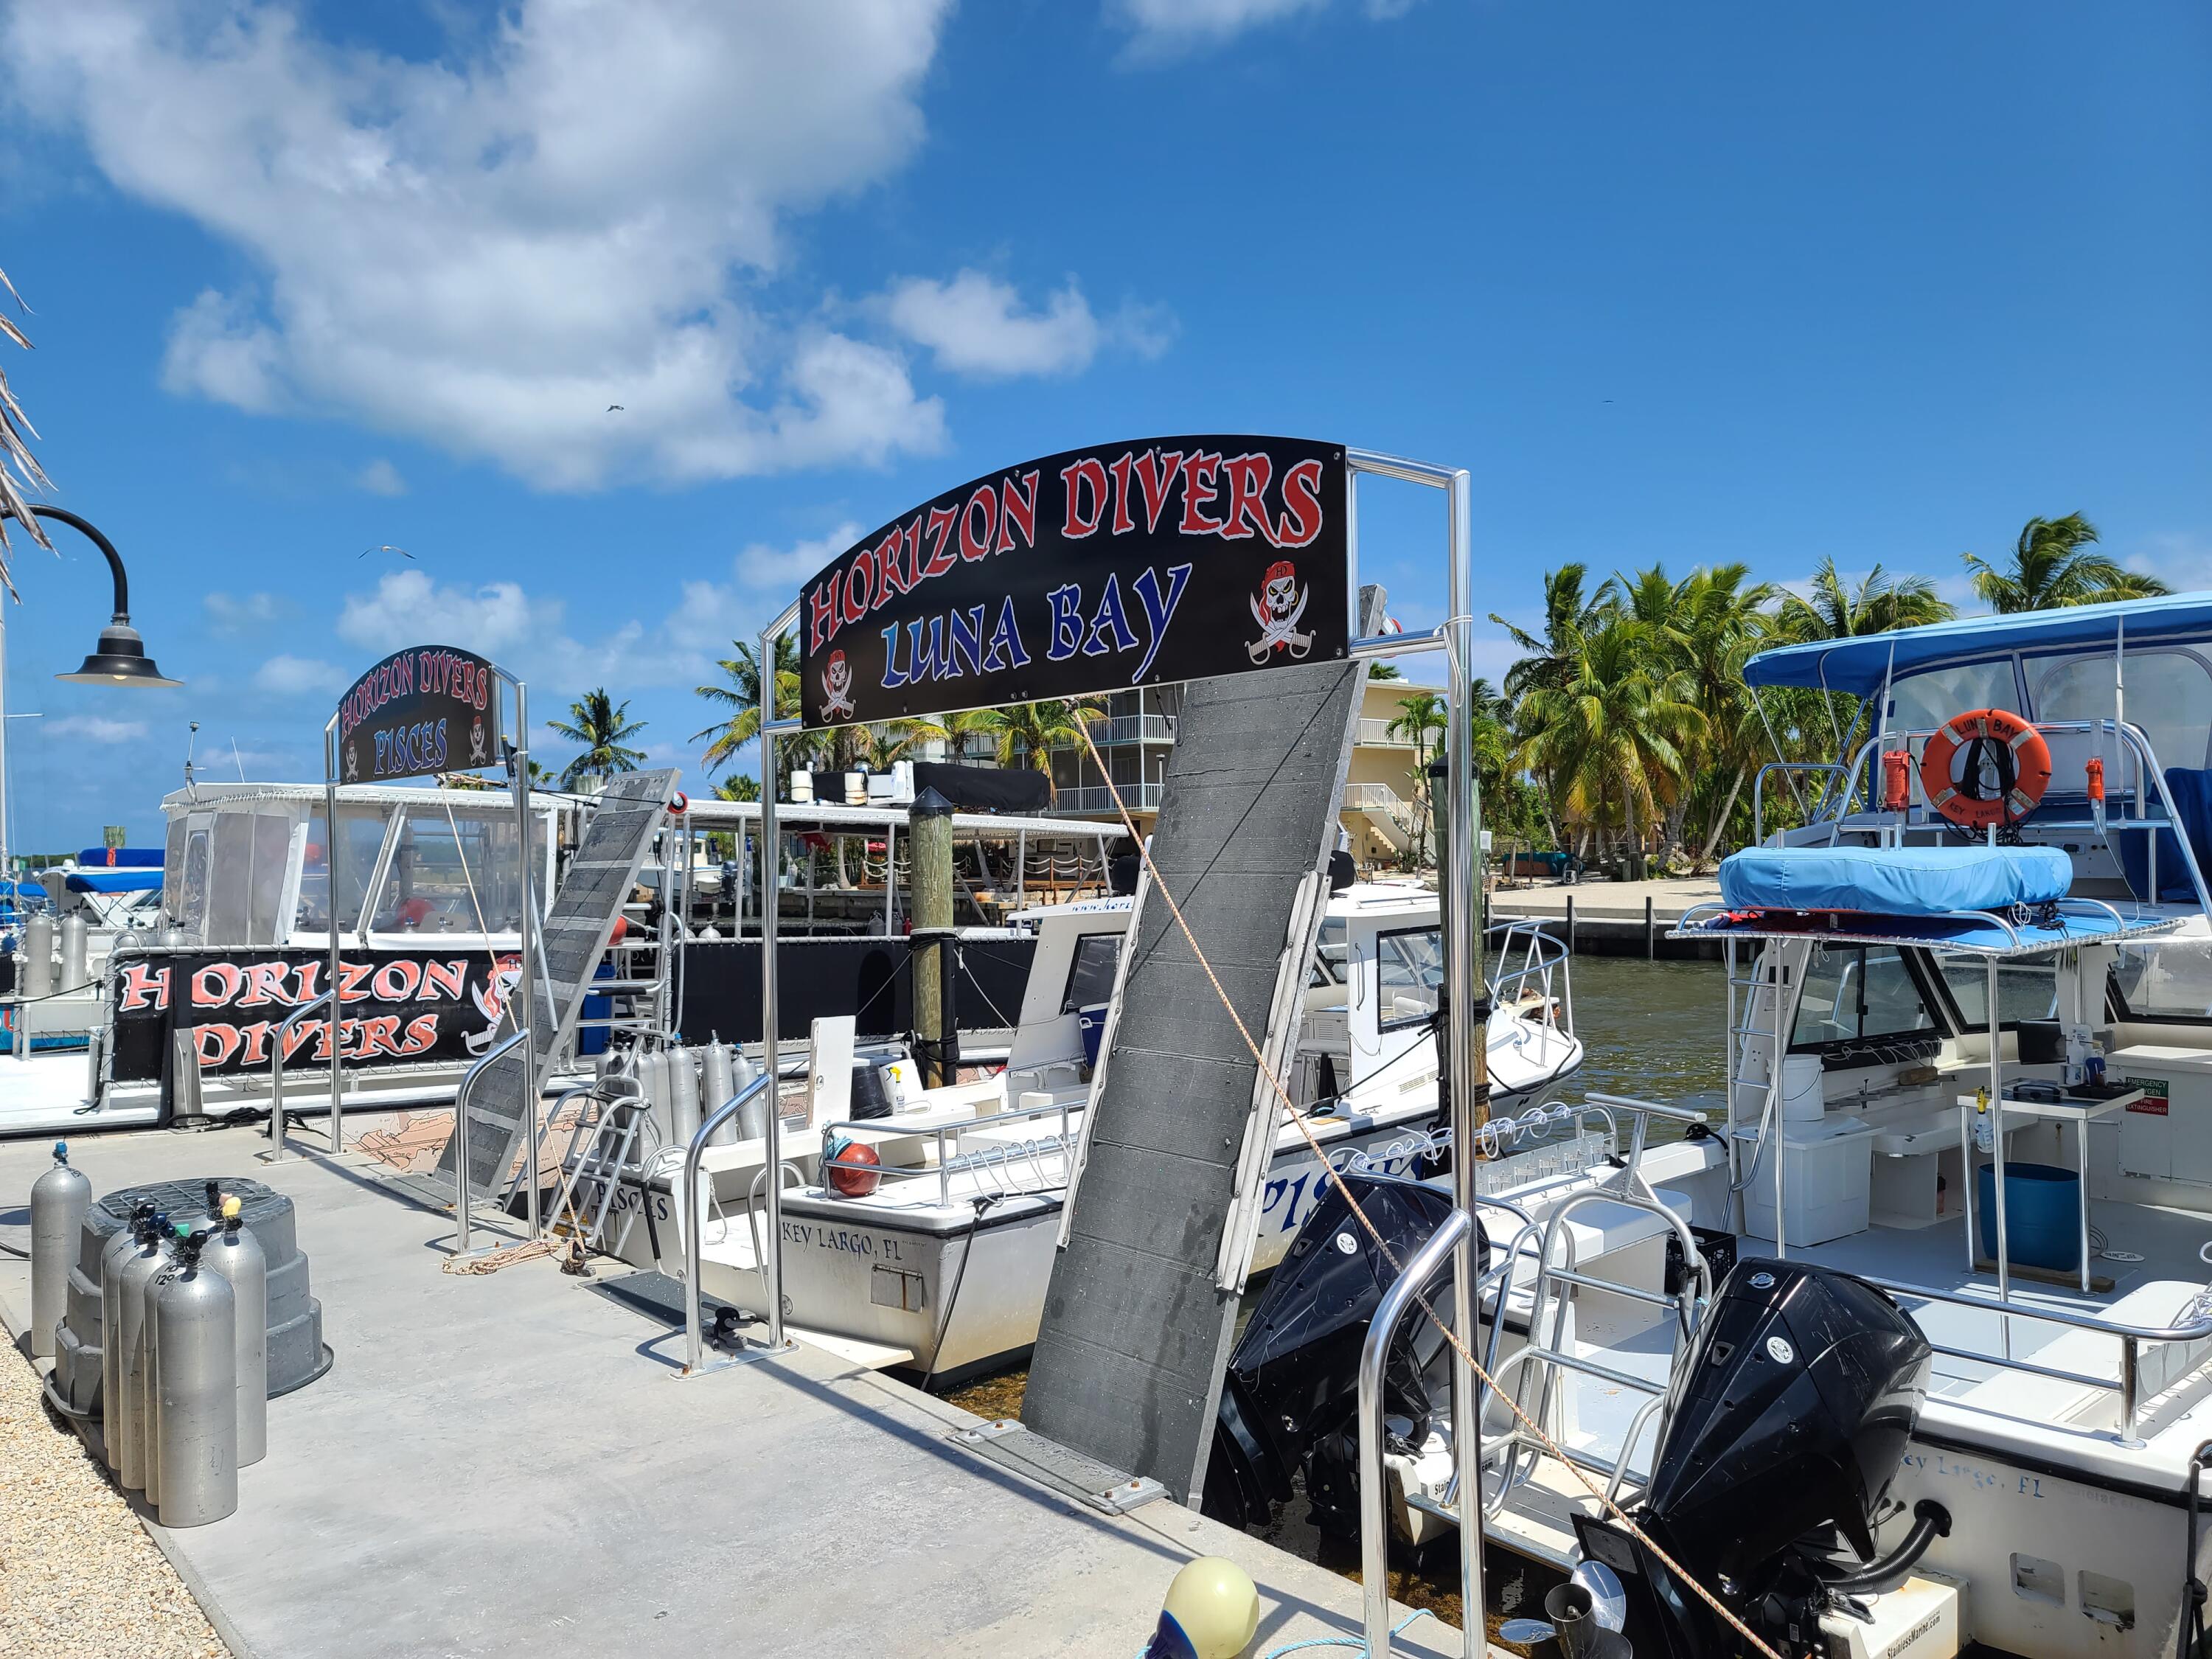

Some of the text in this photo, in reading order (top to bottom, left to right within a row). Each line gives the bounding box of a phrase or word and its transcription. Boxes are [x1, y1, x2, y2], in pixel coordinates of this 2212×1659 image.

[810, 448, 1324, 657] HORIZON DIVERS
[880, 562, 1194, 689] LUNA BAY
[341, 650, 487, 744] HORIZON DIVERS
[374, 718, 448, 774] PISCES
[1955, 717, 2020, 738] LUN BAY
[1073, 899, 1133, 912] www.hori
[119, 959, 467, 1012] HORIZON
[194, 1014, 439, 1068] DIVERS
[2127, 1077, 2167, 1088] EMERGENCY
[2126, 1105, 2167, 1113] EXTINGUISHER
[782, 1222, 903, 1262] KEY LARGO, FL
[1904, 1455, 1927, 1477] ey
[2018, 1475, 2045, 1498] FL
[1888, 1615, 1941, 1659] StainlessMarine.com
